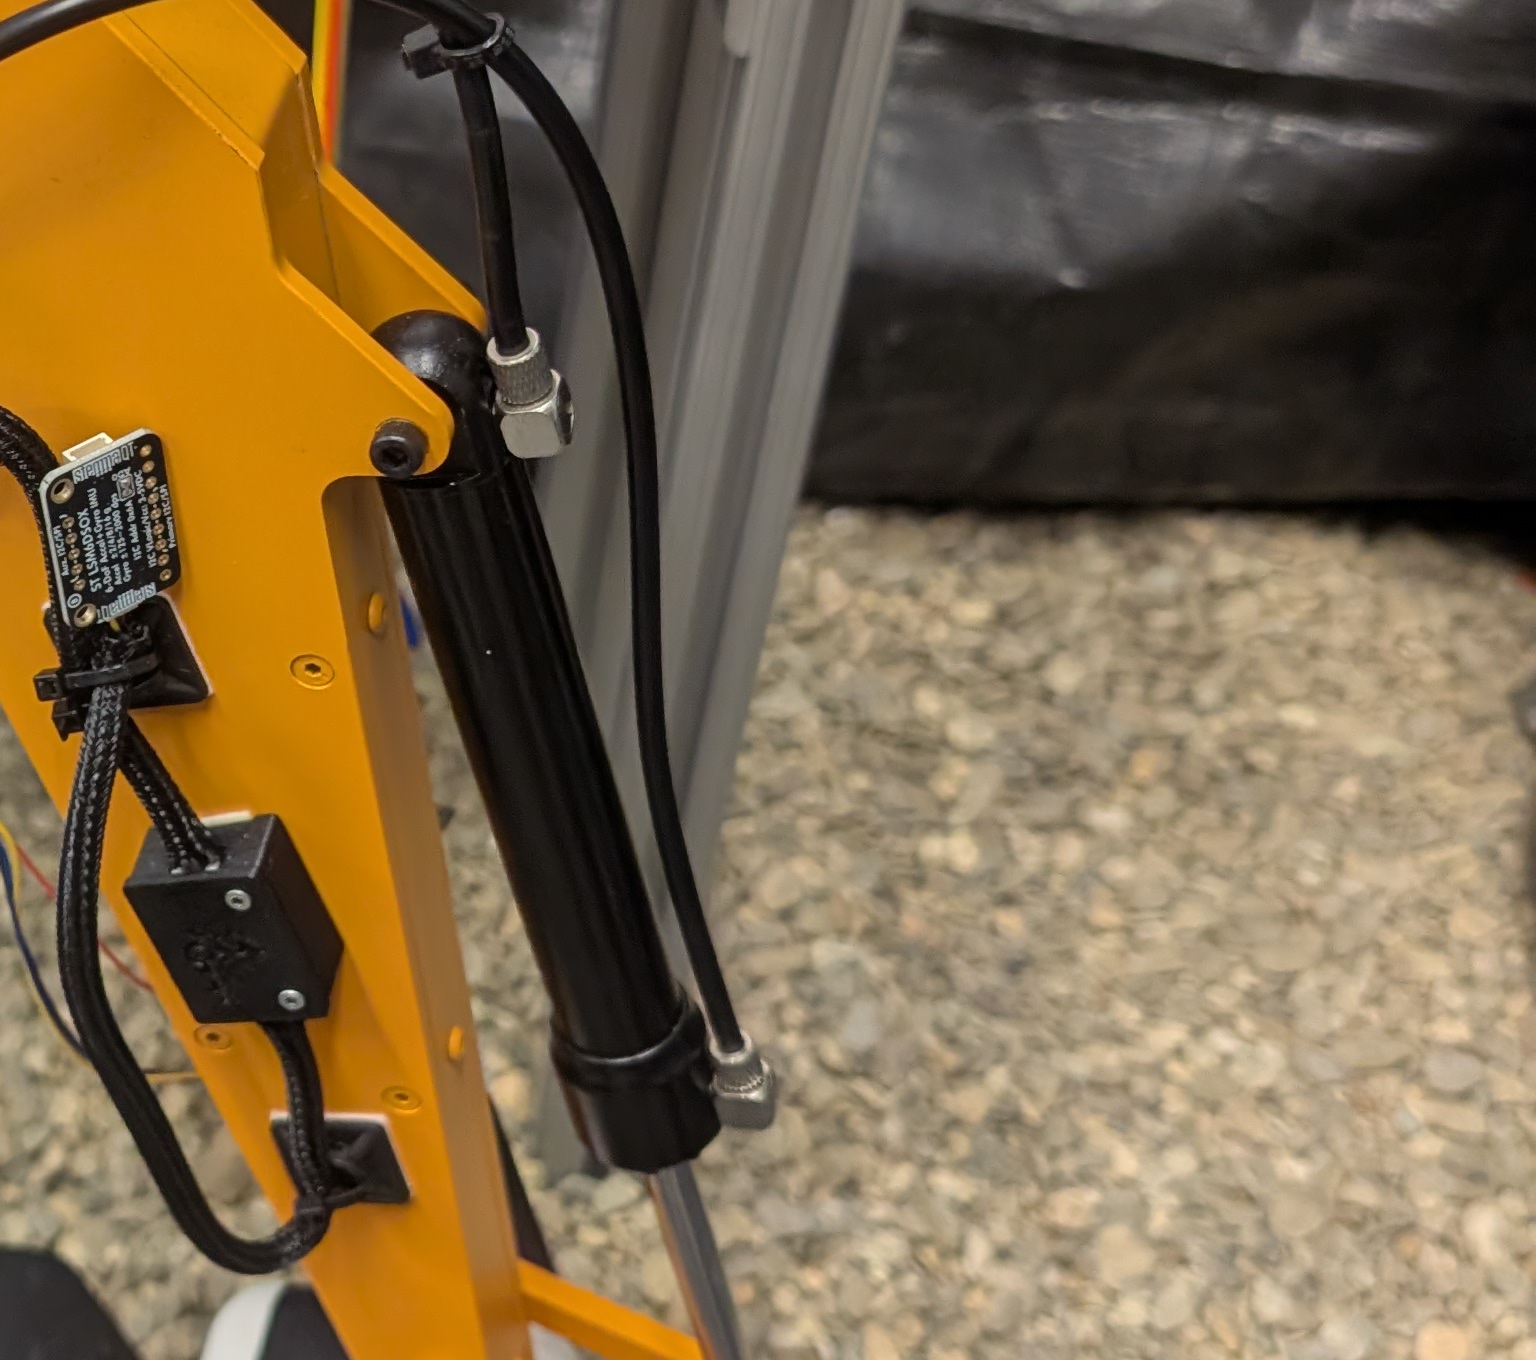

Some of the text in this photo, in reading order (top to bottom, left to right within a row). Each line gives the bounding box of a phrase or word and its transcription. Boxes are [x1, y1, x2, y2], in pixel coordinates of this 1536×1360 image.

[86, 487, 99, 509] IMU
[128, 523, 140, 544] Addr
[76, 507, 103, 593] ST LSM6DSOX
[131, 544, 142, 561] I2C
[146, 551, 157, 568] I2C
[100, 565, 114, 593] 6-DoF
[110, 563, 123, 586] Accel
[122, 561, 133, 583] Gyro
